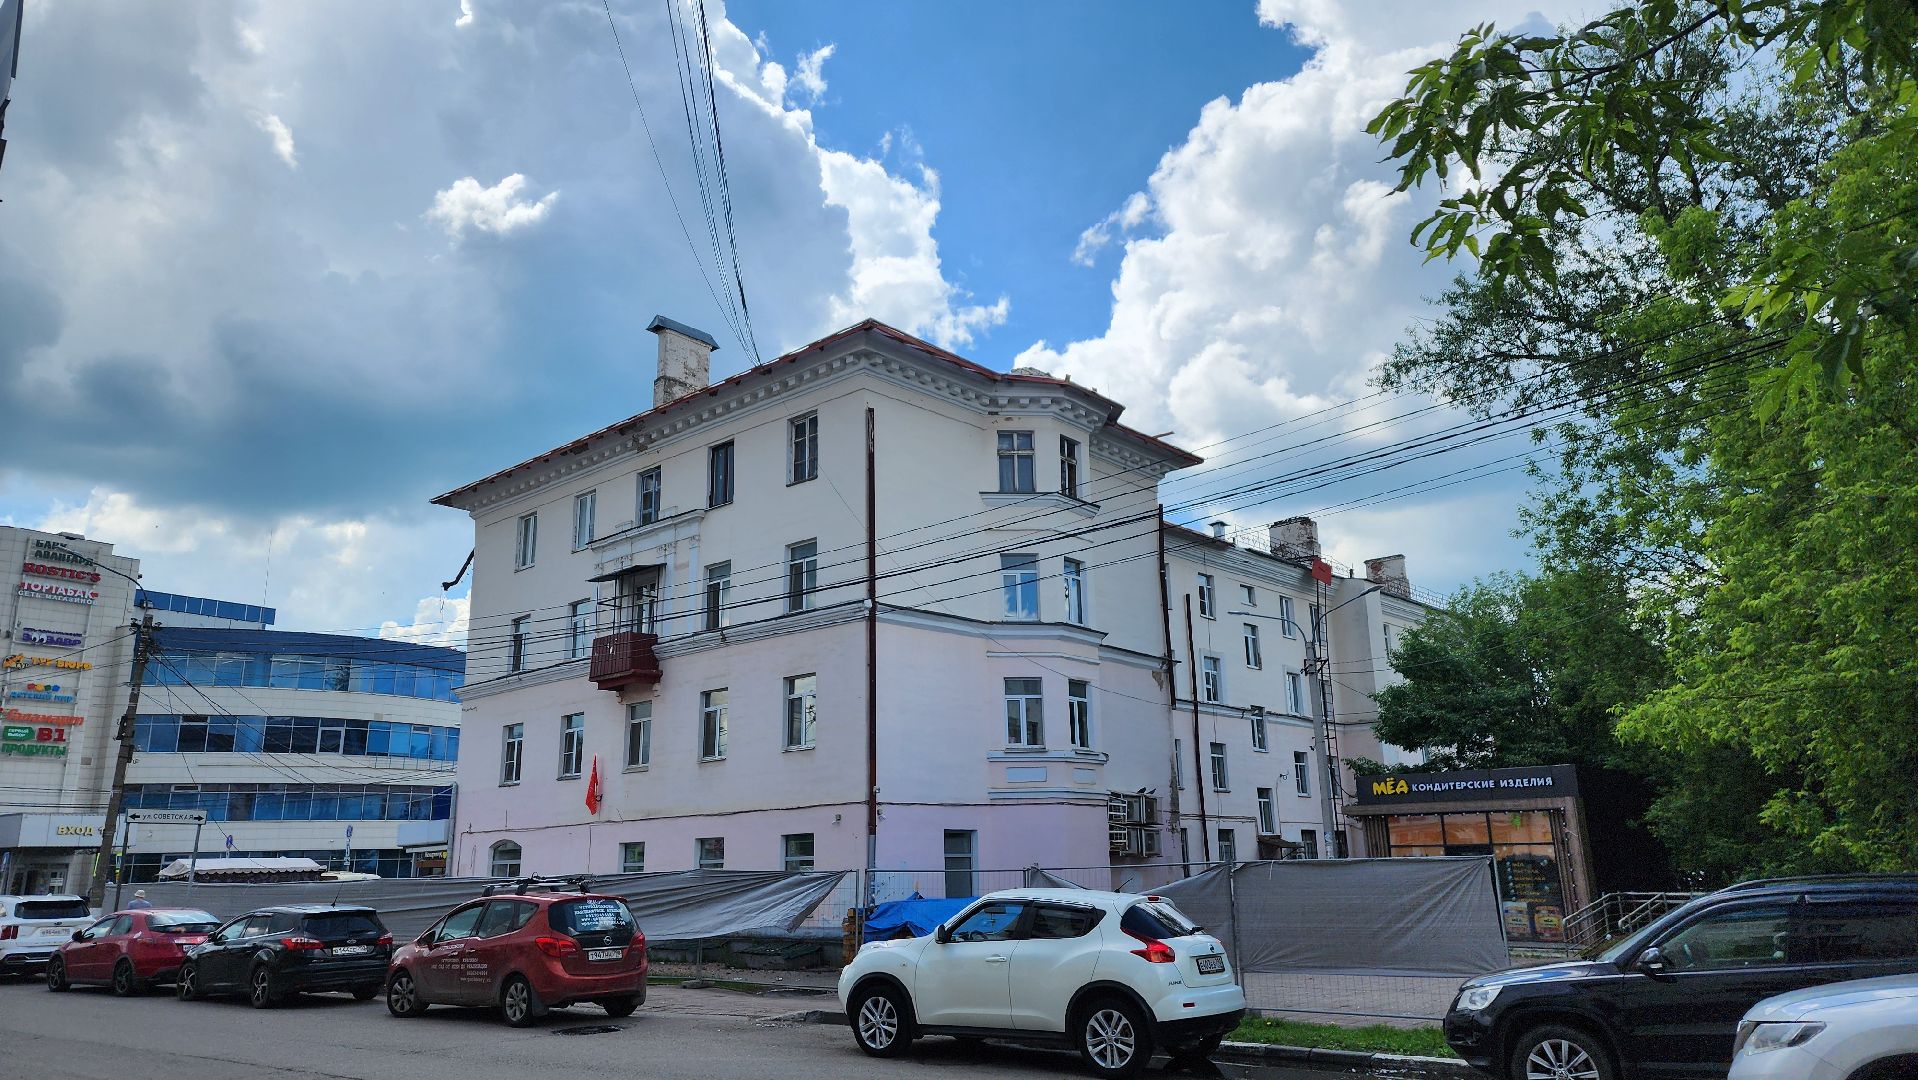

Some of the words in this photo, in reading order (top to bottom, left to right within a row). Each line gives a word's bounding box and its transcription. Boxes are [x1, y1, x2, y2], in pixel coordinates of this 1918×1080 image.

[23, 562, 101, 582] ROSTIC'S
[1, 743, 67, 757] ПРОДУКТЫ
[1411, 780, 1495, 792] КОНДИТЕРСКИЕ
[1500, 776, 1553, 788] ИЗДЕЛИЯ
[56, 824, 94, 837] ВХОД
